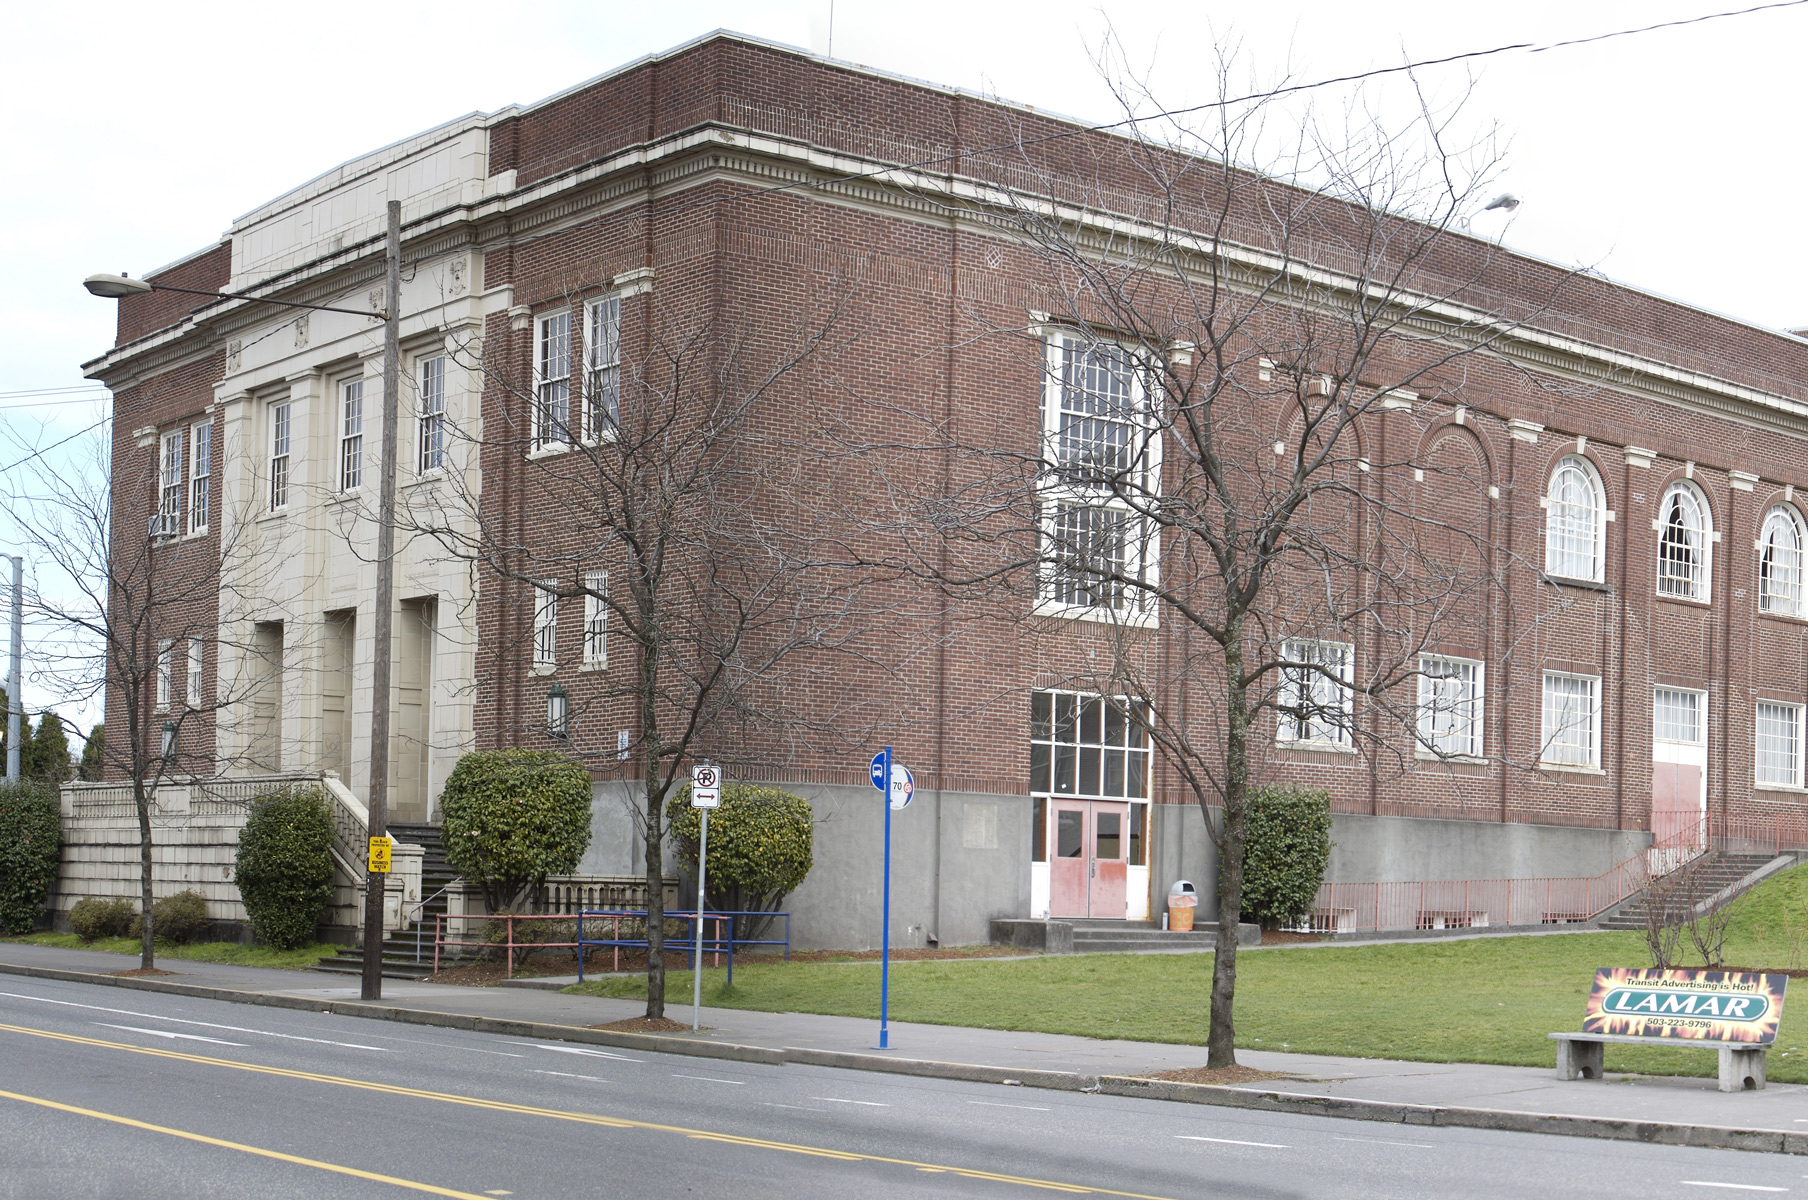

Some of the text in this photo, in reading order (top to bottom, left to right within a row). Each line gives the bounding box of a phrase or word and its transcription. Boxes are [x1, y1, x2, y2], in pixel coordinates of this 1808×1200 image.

[892, 781, 903, 791] 70
[1626, 978, 1754, 992] Transit Advertising is Hot!
[1614, 992, 1750, 1017] LAMAR
[1646, 1018, 1712, 1029] 503-223-9796
